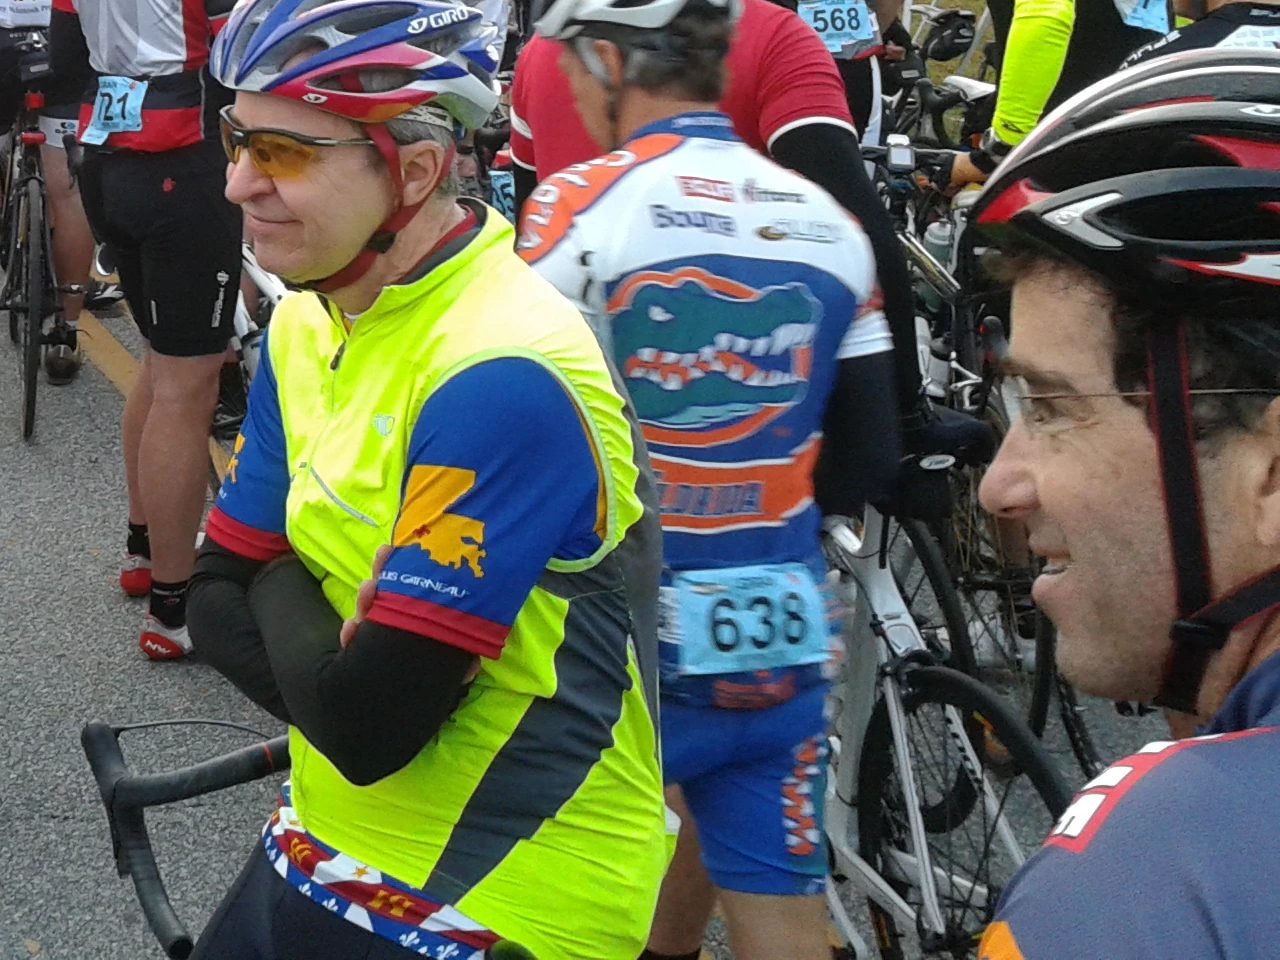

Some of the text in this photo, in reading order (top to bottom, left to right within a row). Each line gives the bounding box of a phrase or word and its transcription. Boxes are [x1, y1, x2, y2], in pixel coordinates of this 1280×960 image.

[429, 6, 469, 28] GIRO
[813, 7, 861, 32] 568
[400, 573, 465, 598] GARNEAU
[710, 592, 808, 652] 638
